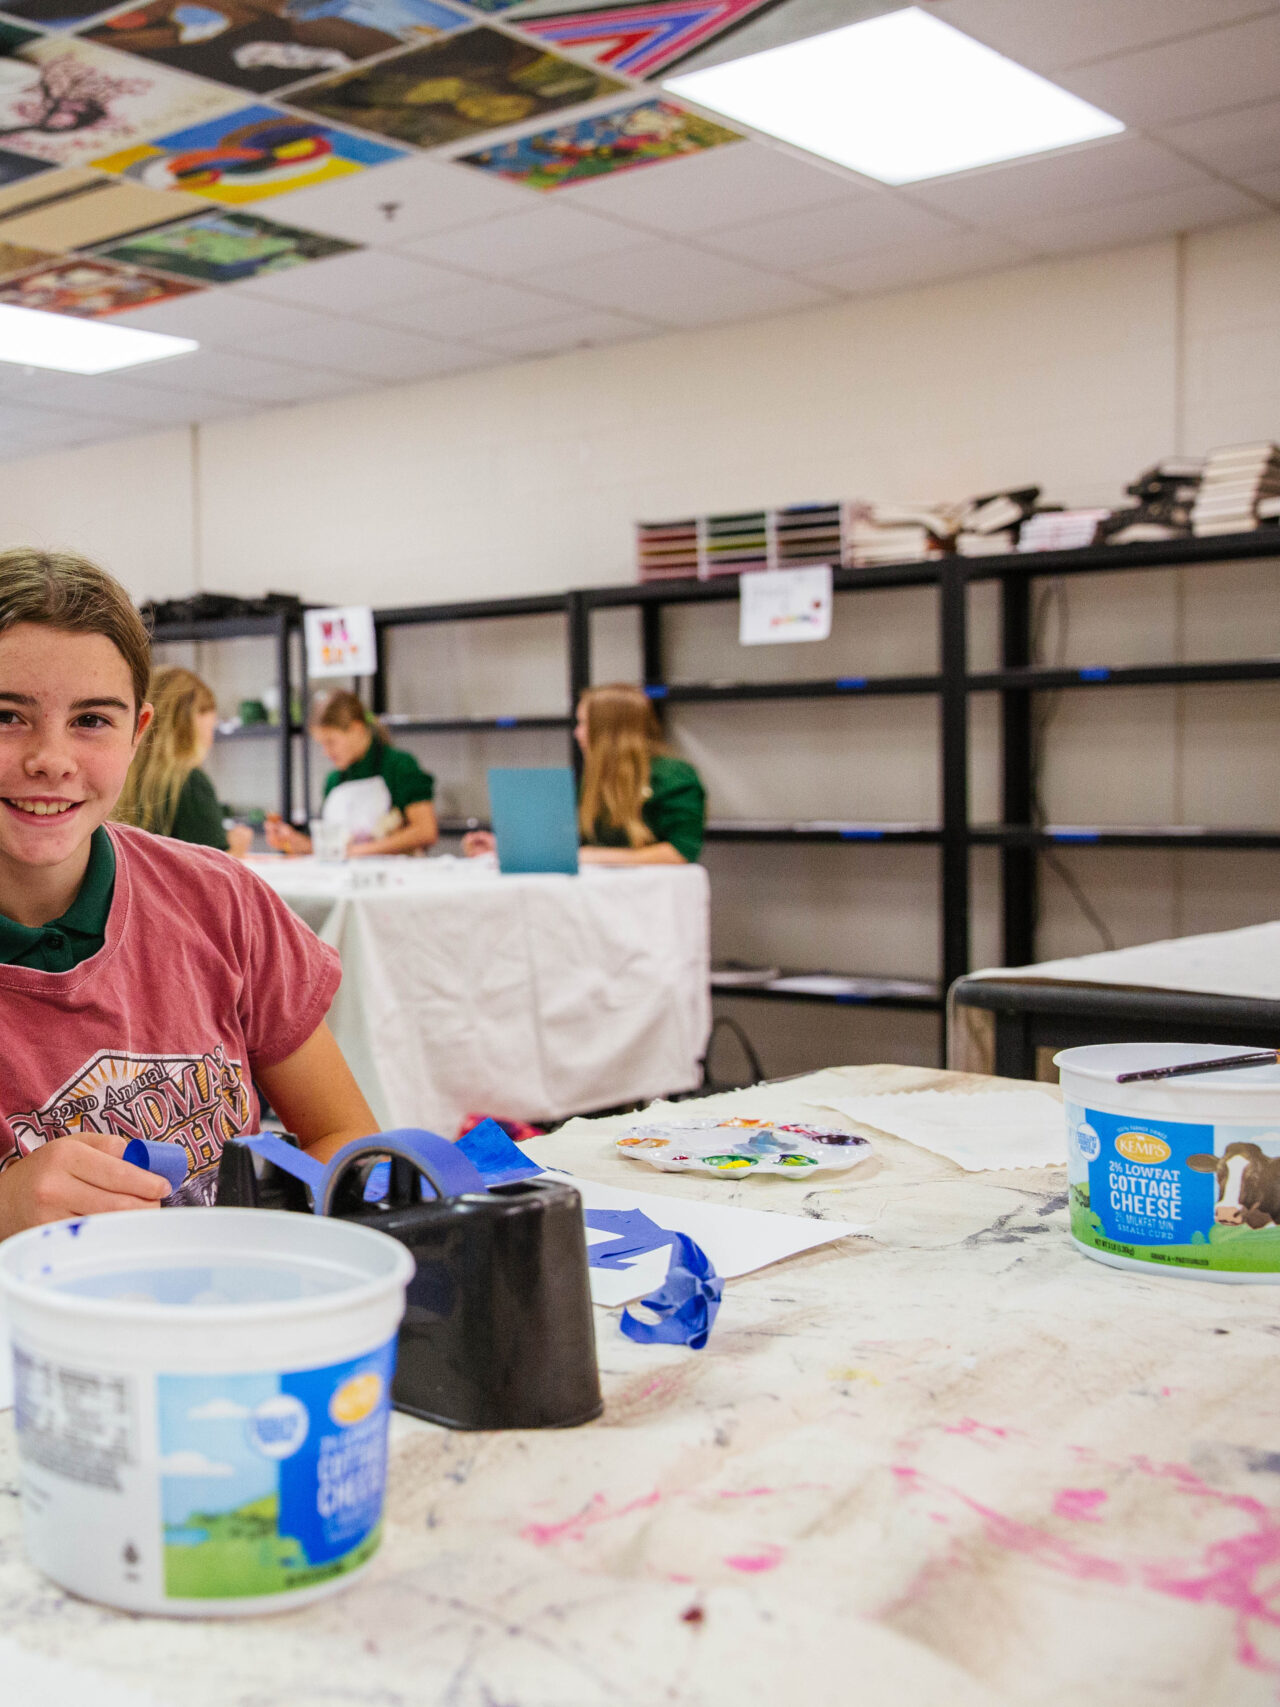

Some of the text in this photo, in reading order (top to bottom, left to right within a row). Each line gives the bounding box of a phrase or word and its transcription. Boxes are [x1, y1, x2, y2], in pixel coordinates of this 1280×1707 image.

[50, 1060, 170, 1128] 32ND Annual
[1109, 1160, 1181, 1182] 2% LOWFAT
[1109, 1173, 1182, 1200] COTTAGE
[1111, 1190, 1182, 1221] CHEESE
